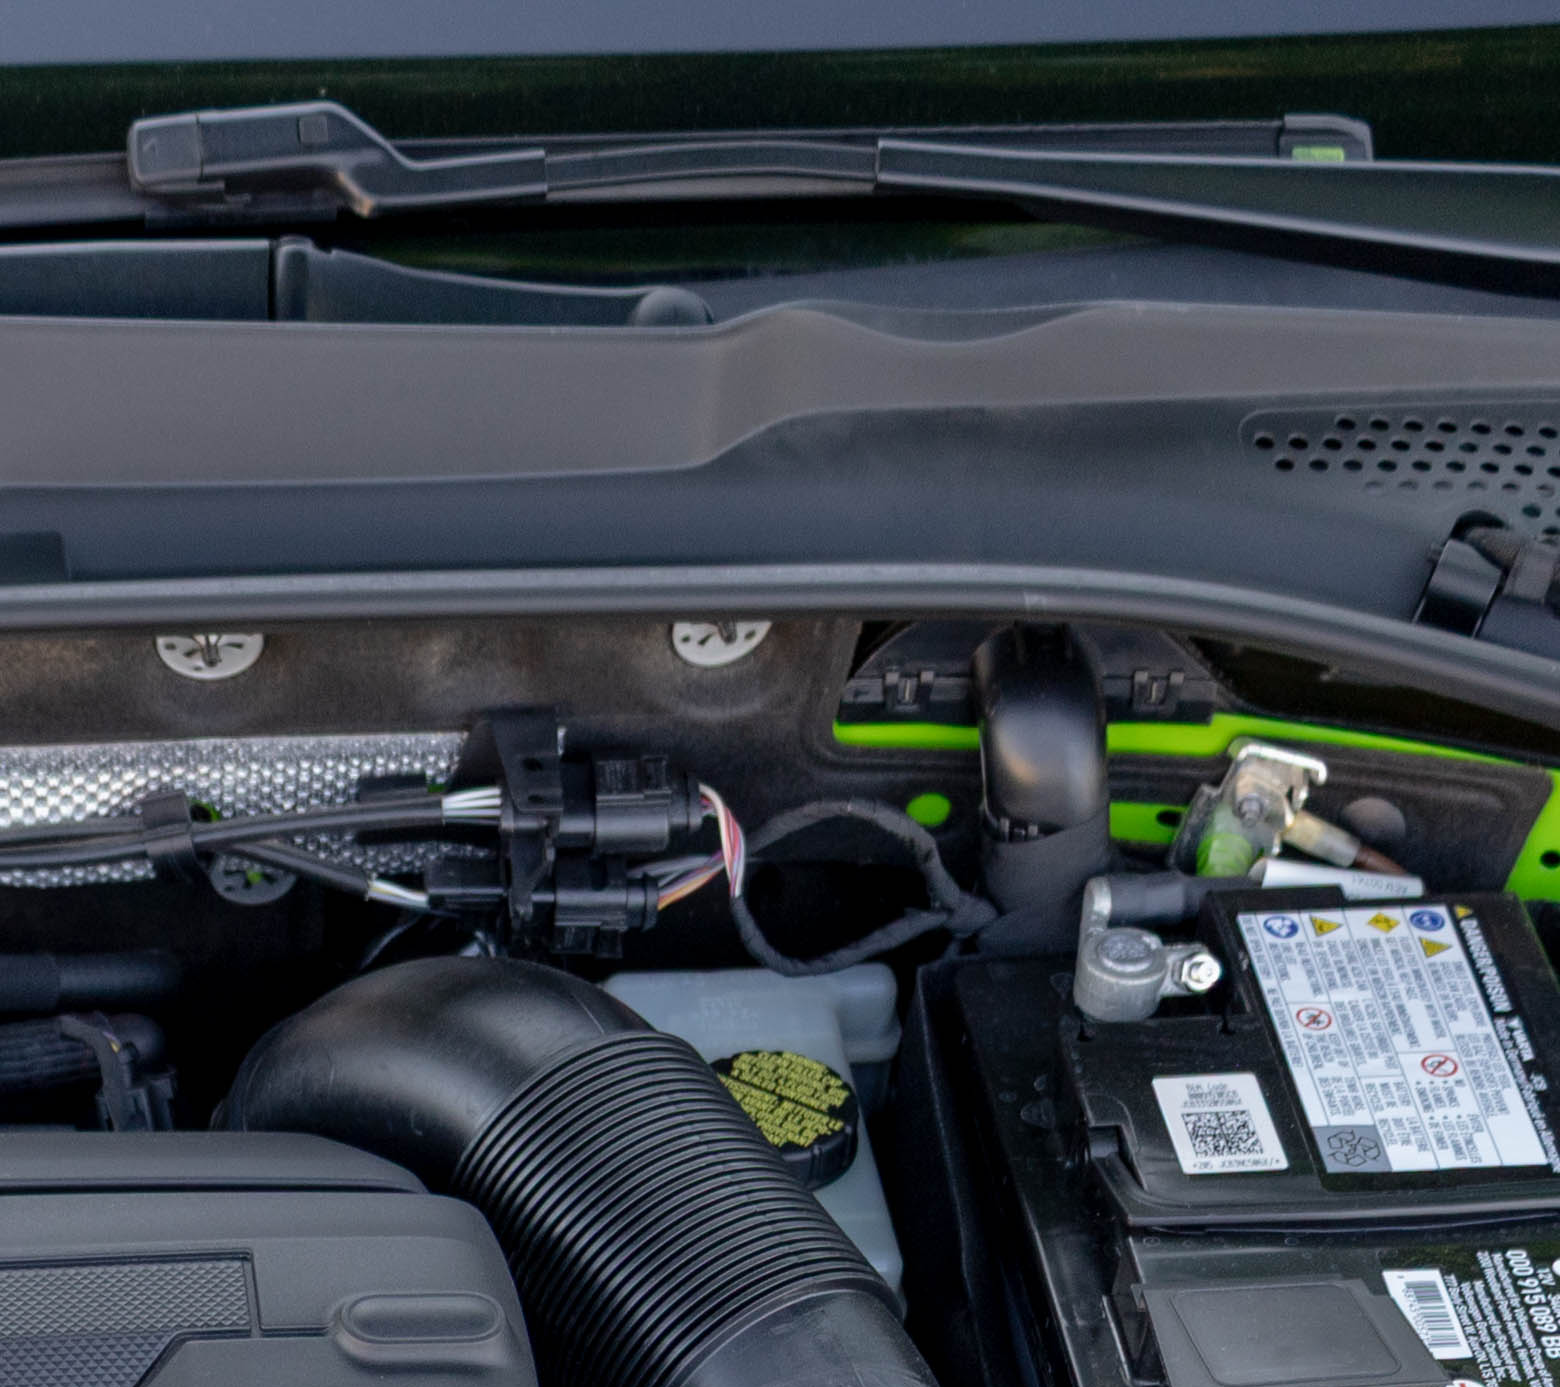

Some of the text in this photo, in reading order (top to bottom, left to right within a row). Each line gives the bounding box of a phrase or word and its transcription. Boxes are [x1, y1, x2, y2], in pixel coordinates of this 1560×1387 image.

[1506, 1250, 1533, 1276] 000
[1536, 1268, 1556, 1286] 12V
[1518, 1277, 1545, 1304] 915
[1530, 1307, 1557, 1333] 089
